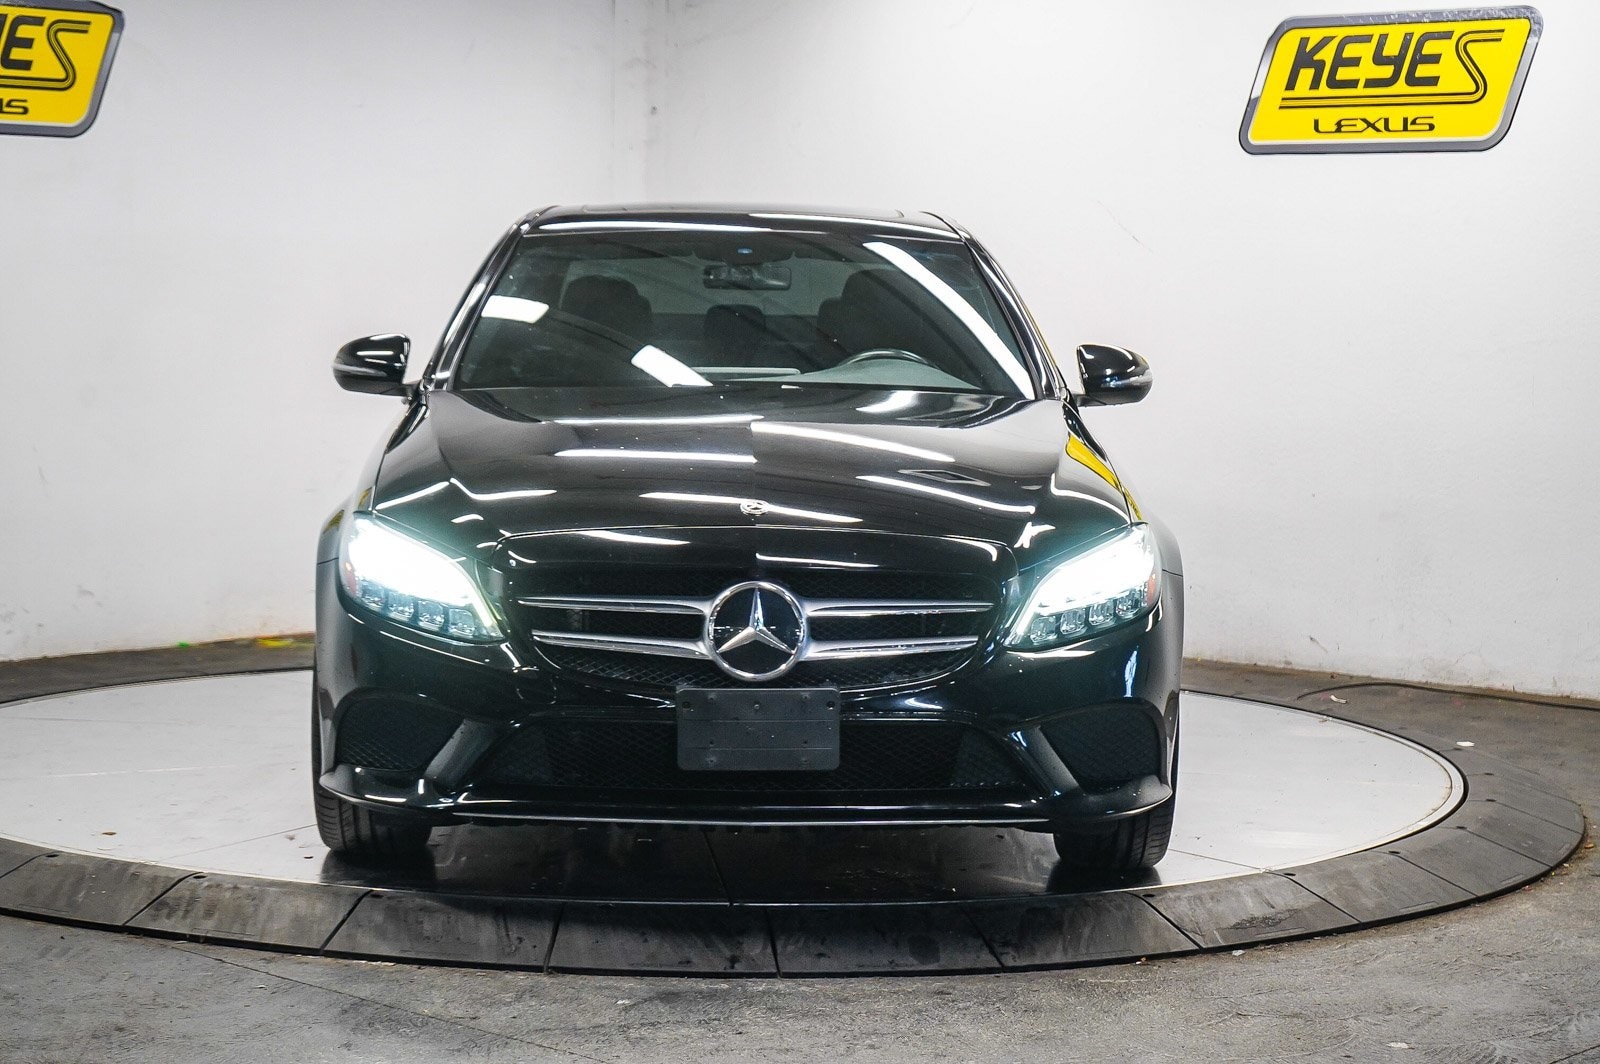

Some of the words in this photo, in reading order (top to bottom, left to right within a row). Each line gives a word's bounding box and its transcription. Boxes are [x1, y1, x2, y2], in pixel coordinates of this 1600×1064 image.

[0, 14, 92, 91] ES
[1279, 29, 1505, 108] KEYES
[1313, 116, 1436, 134] LEXUS
